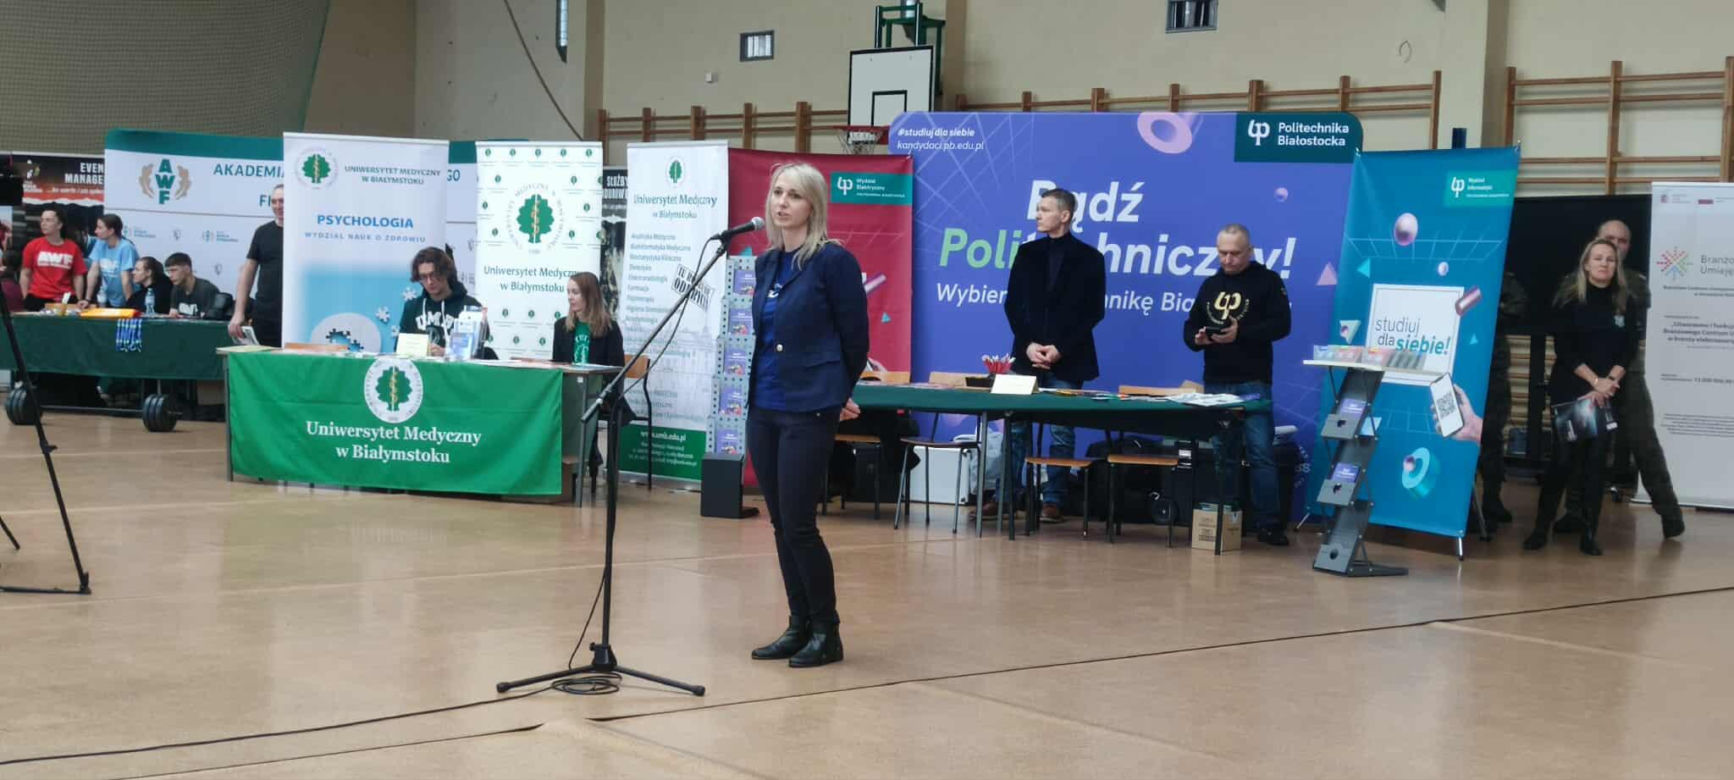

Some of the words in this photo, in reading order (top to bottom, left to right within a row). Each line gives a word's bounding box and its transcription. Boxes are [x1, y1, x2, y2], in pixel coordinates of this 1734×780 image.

[934, 128, 948, 136] dla
[949, 128, 975, 137] siebie
[1278, 122, 1349, 133] Politechnika
[1277, 135, 1346, 146] Białostocka
[345, 166, 398, 174] UNIWERSYTET
[399, 168, 441, 176] MEDYCZNY
[317, 214, 414, 229] PSYCHOLOGIA
[483, 266, 537, 278] Uniwersytet
[511, 281, 565, 294] Białymstoku
[1375, 317, 1421, 337] studiuj
[1377, 333, 1395, 346] dla
[1396, 334, 1451, 355] siebie!
[306, 421, 400, 441] Uniwersytet
[403, 426, 482, 446] Medyczny
[336, 447, 349, 457] w
[352, 444, 450, 463] Białymstoku
